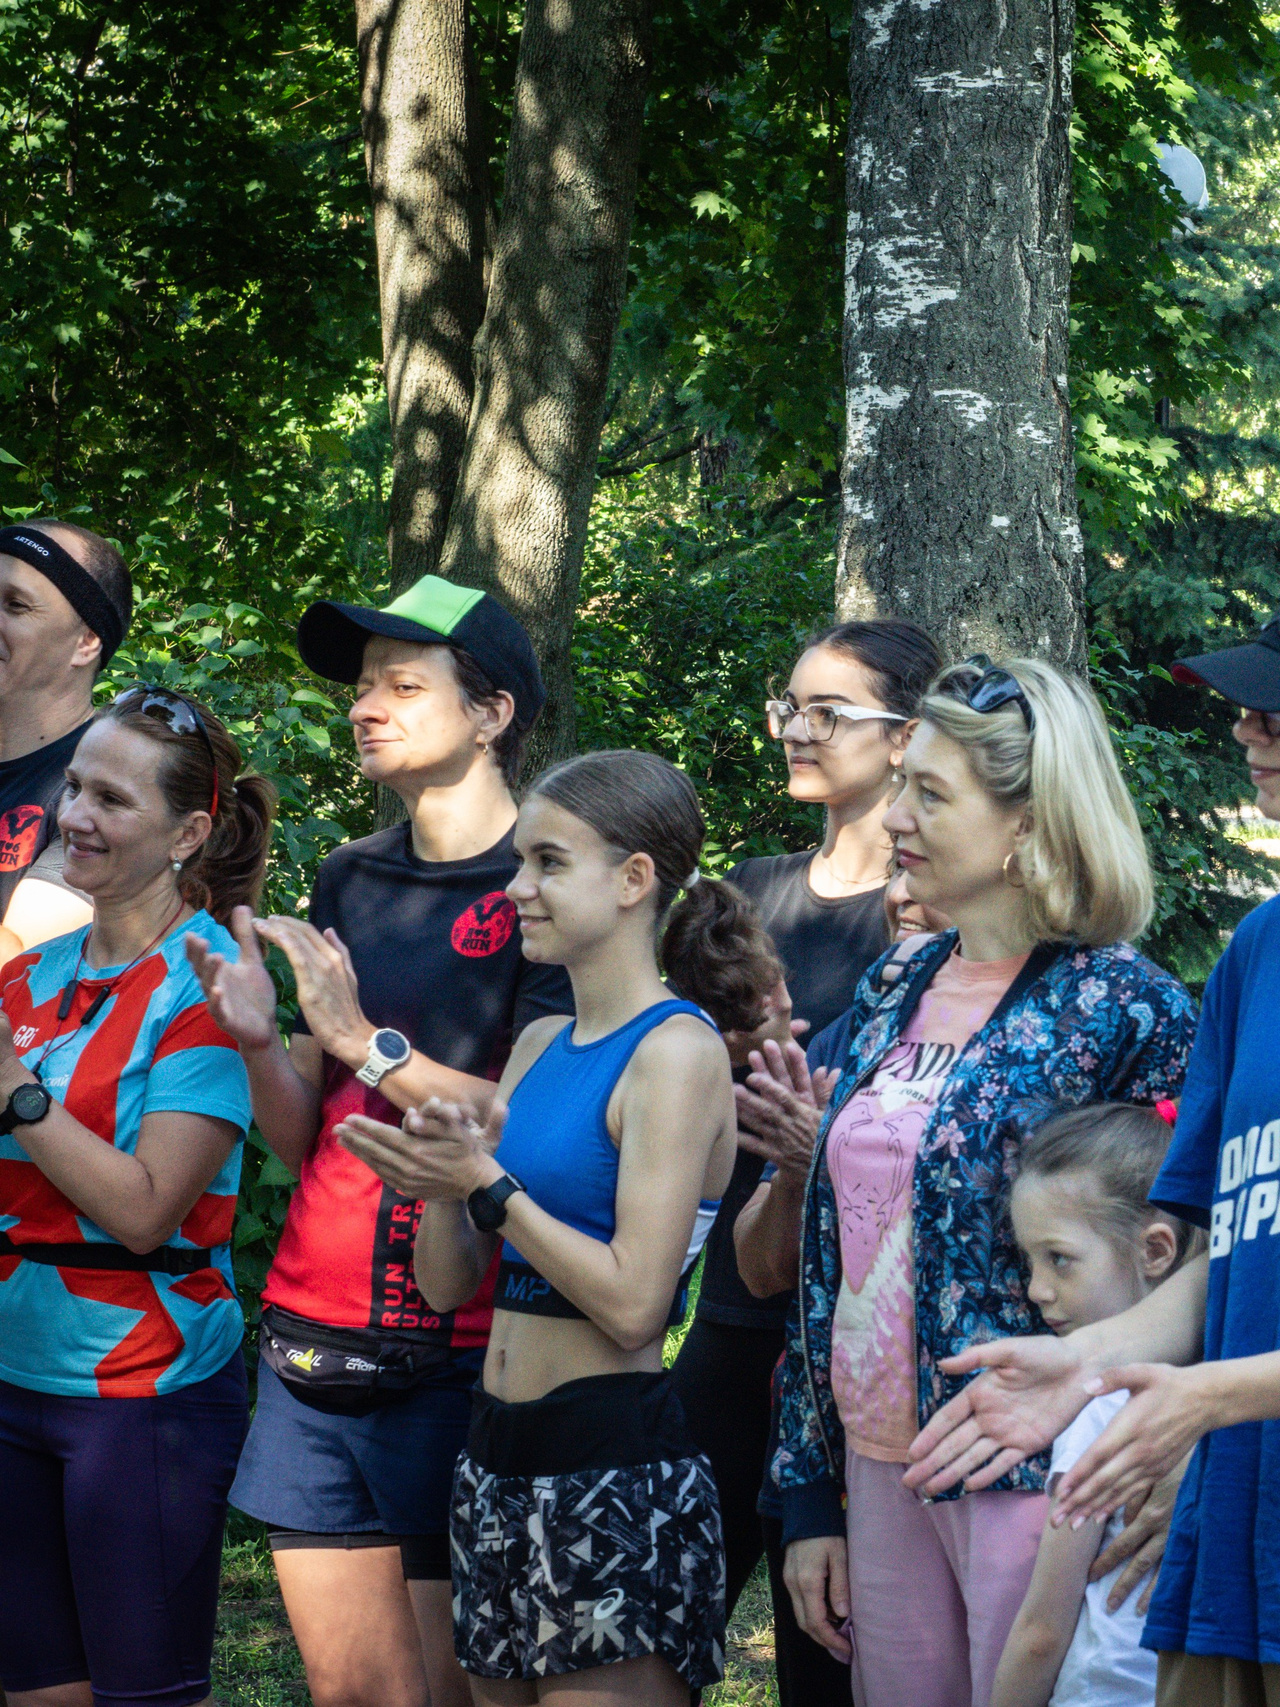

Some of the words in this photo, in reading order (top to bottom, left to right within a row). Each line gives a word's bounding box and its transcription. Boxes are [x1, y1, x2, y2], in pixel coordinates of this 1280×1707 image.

[13, 535, 50, 556] ARTENGO
[0, 852, 20, 867] UN
[461, 938, 492, 952] RUN
[381, 1263, 405, 1329] RUN
